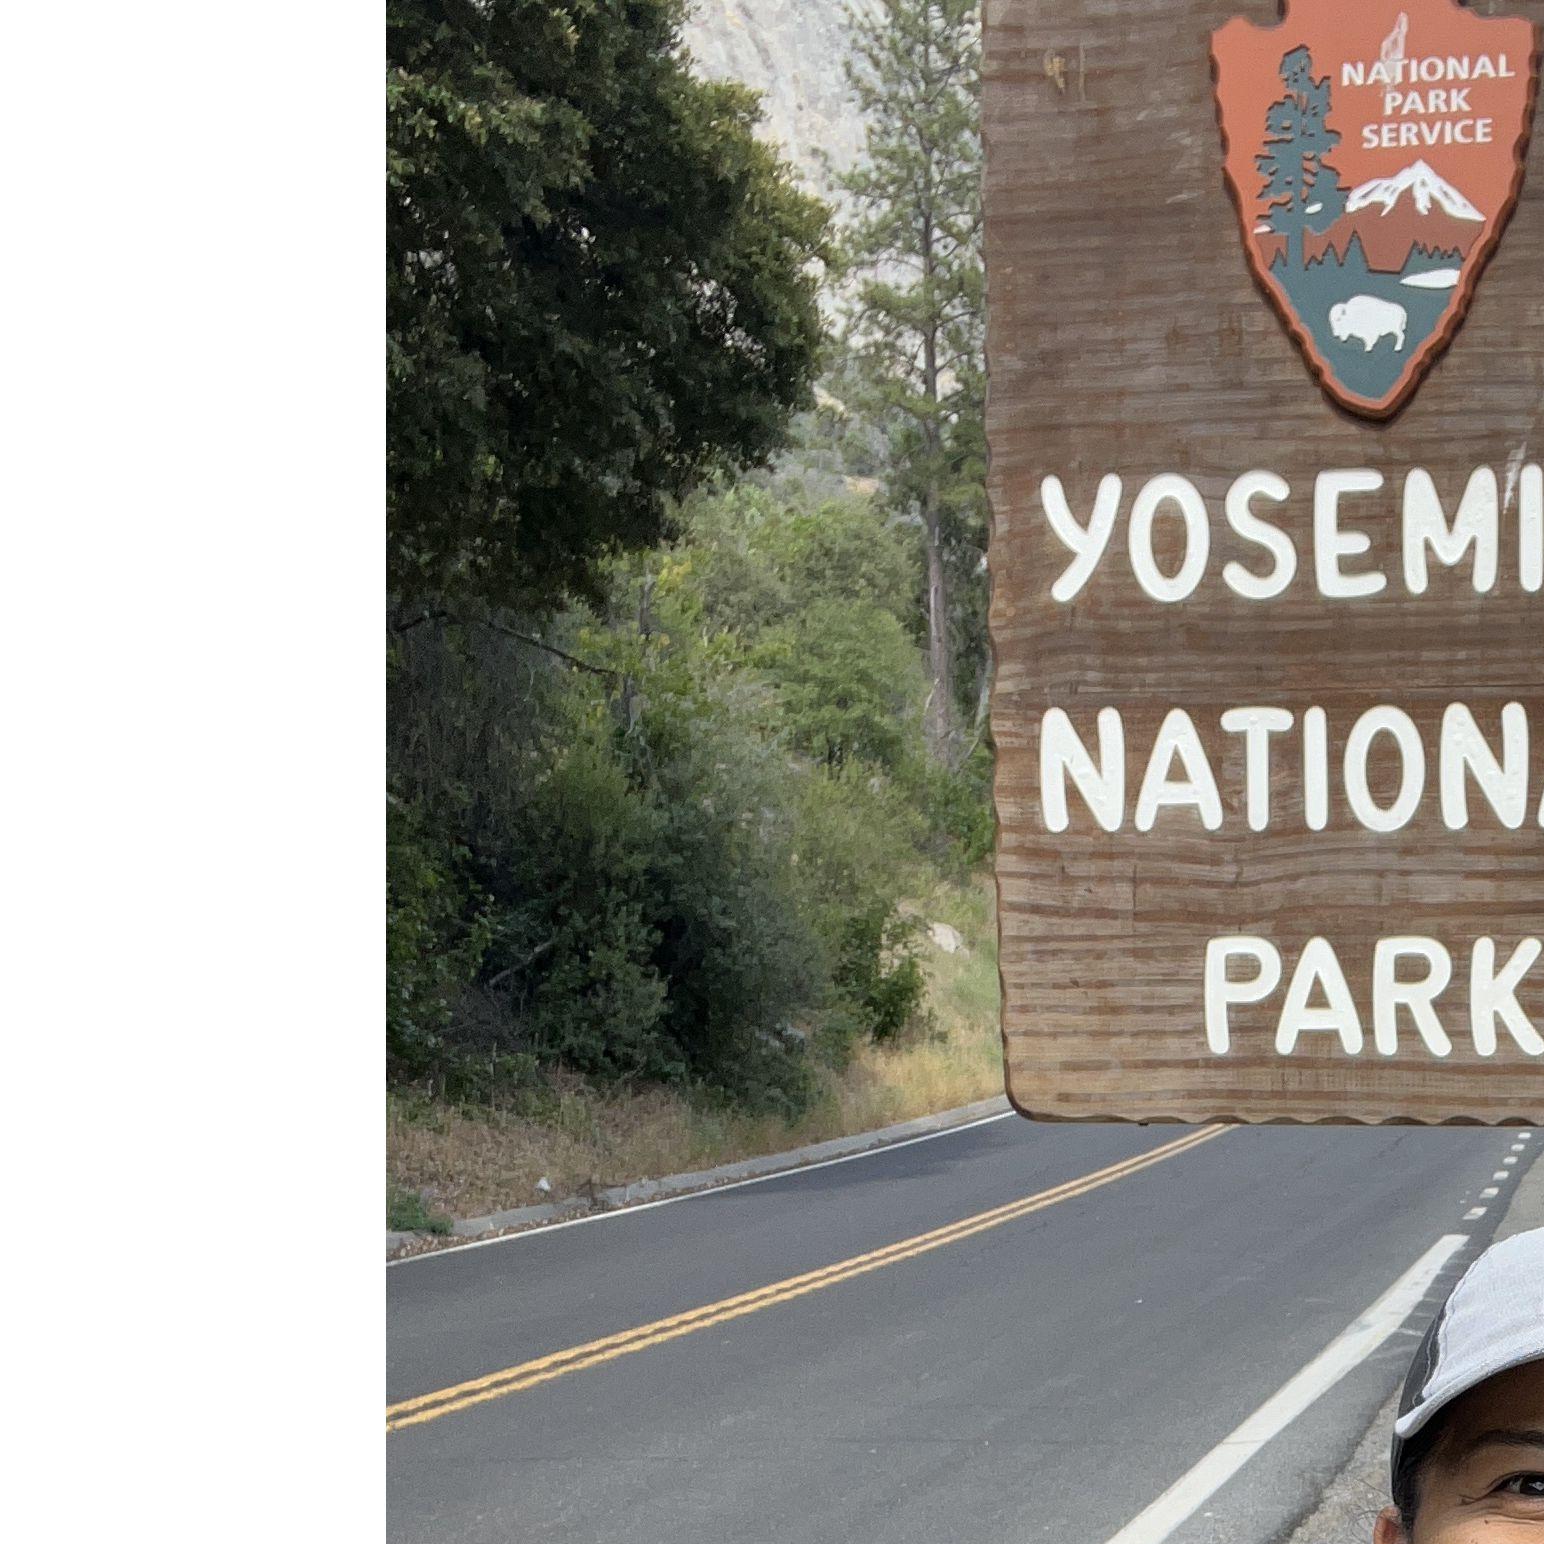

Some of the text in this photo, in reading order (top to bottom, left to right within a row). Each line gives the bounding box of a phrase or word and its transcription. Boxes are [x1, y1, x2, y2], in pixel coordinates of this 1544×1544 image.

[1341, 53, 1515, 87] NATIONAL
[1384, 87, 1472, 116] PARK
[1361, 117, 1493, 149] SERVICE
